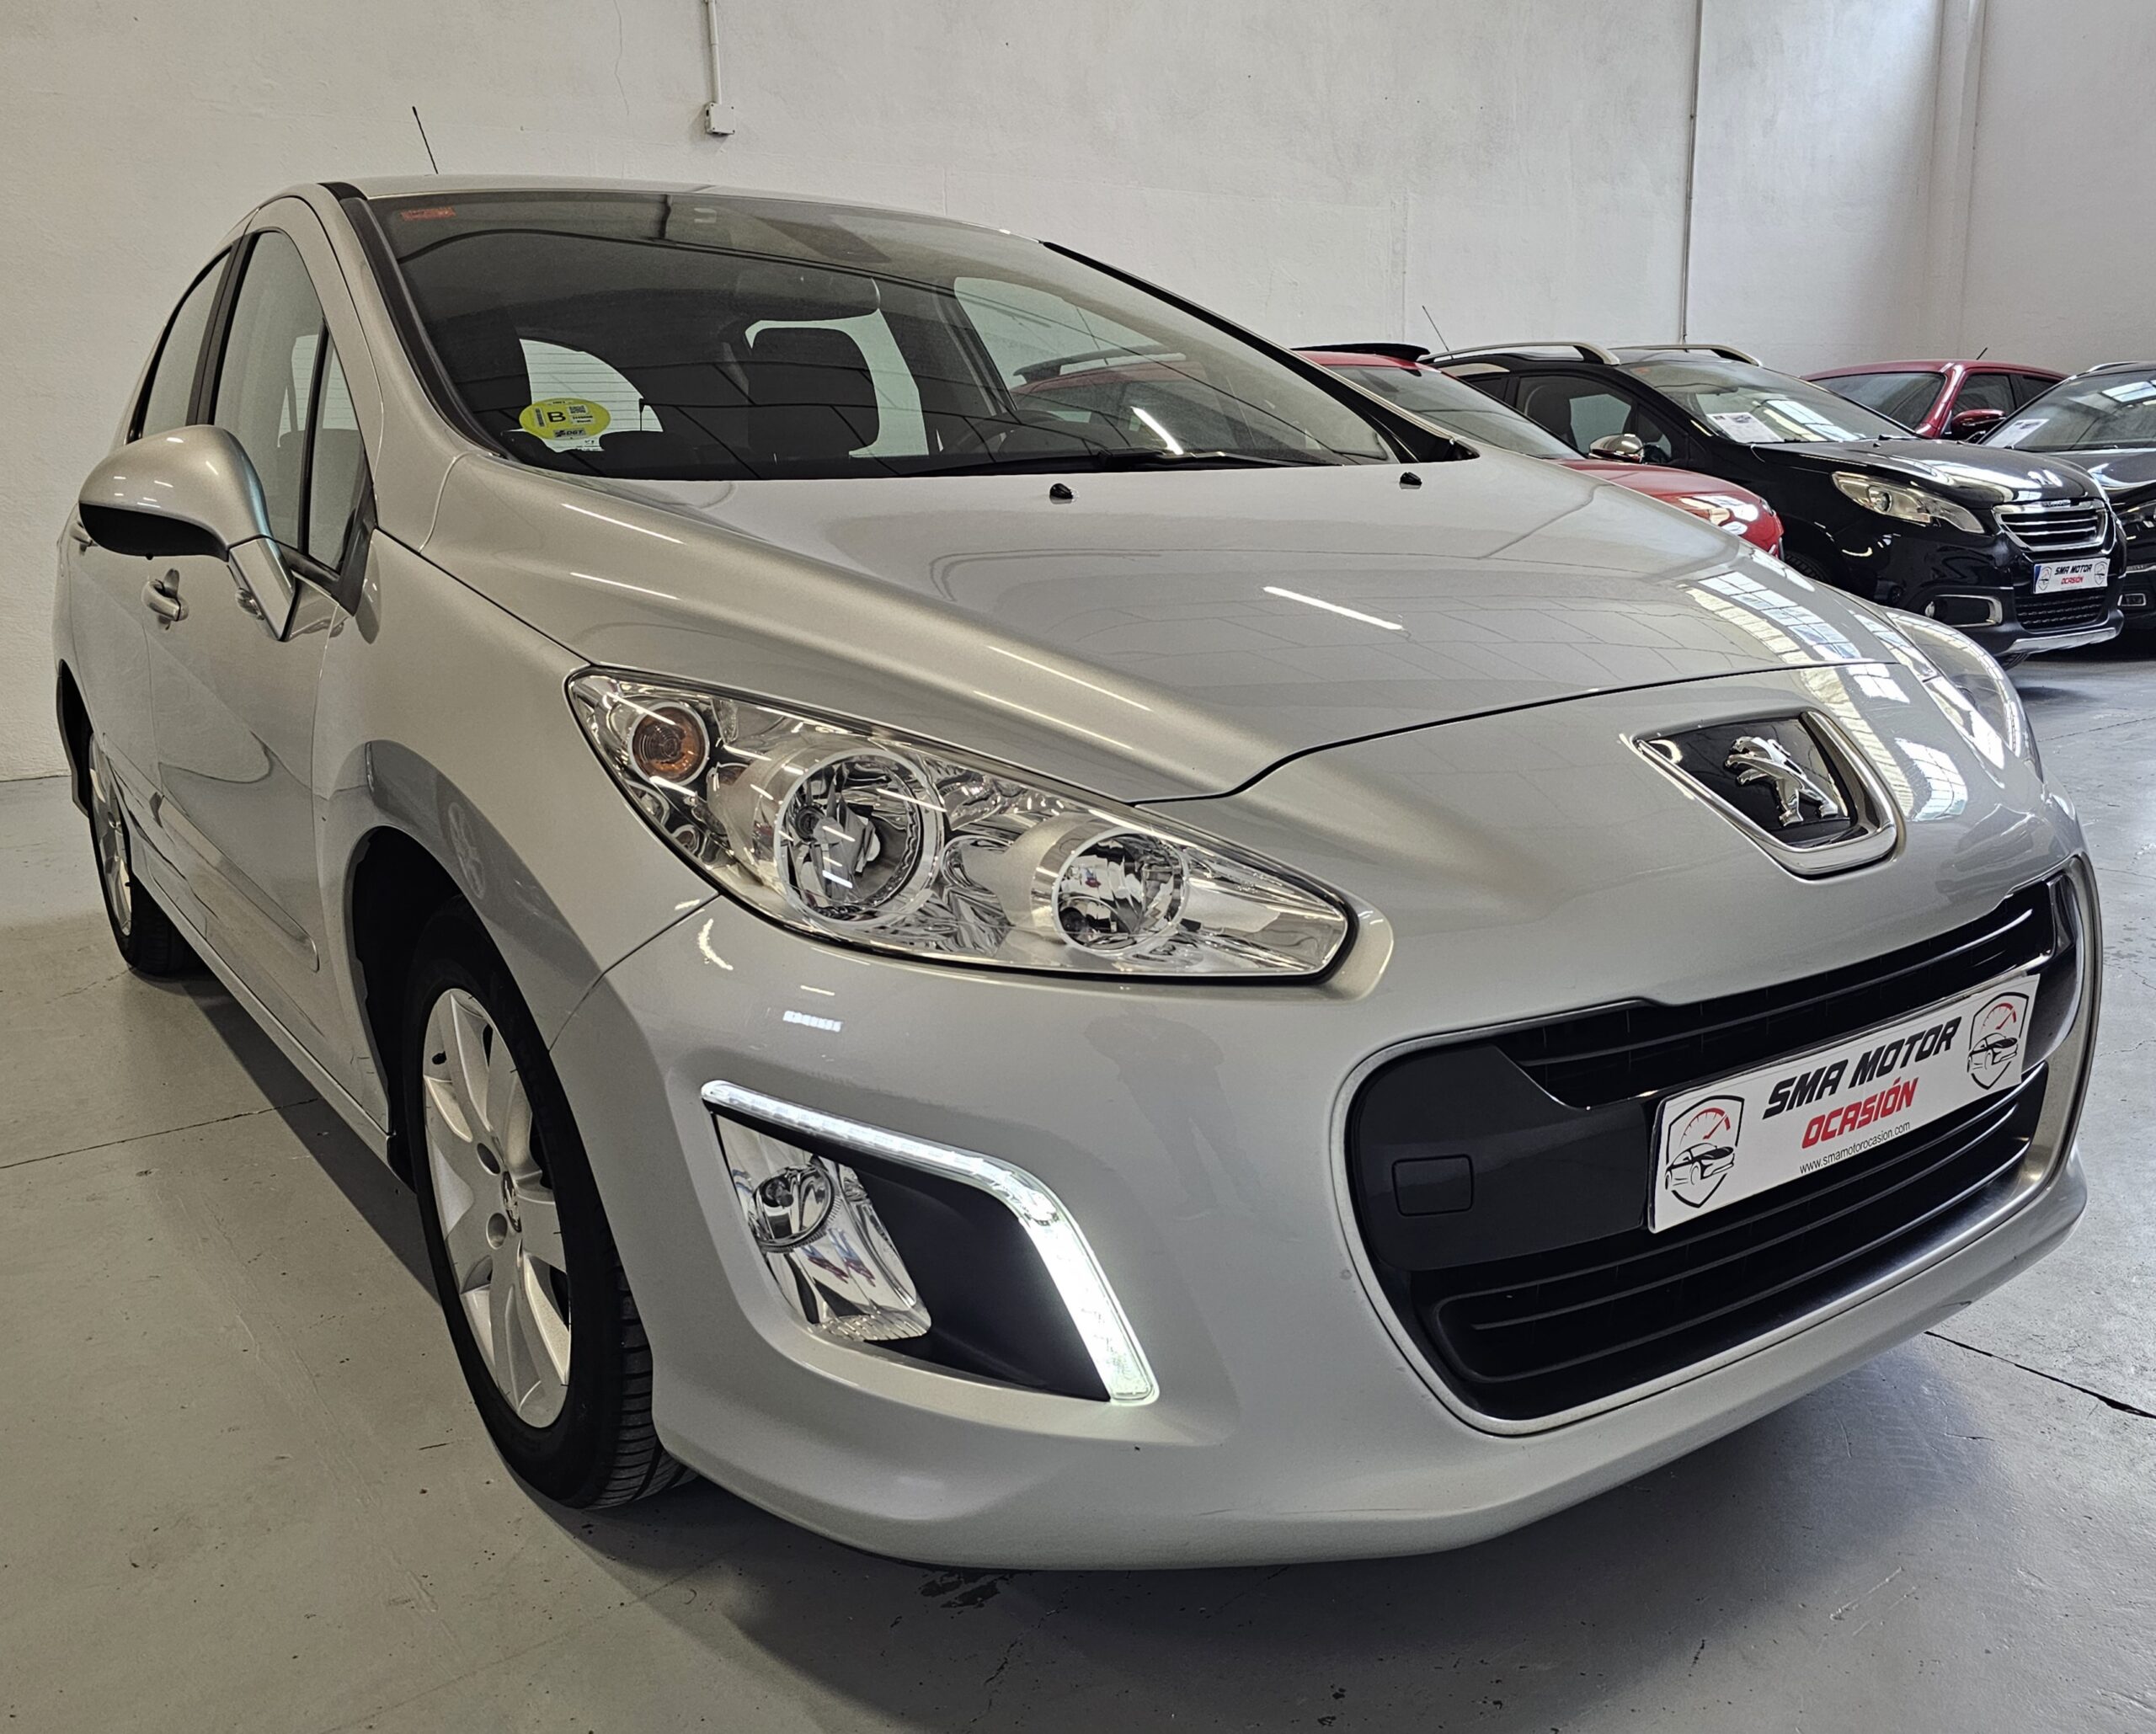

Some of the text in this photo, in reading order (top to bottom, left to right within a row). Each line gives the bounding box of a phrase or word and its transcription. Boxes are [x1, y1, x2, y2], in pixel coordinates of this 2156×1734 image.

[547, 411, 566, 423] B
[2055, 564, 2092, 574] SMA MOTOR
[1762, 1016, 1962, 1120] SMA MOTOR
[1801, 1076, 1919, 1150] OCASIÓN
[1799, 1121, 1911, 1174] www.smamotorocasion.com
